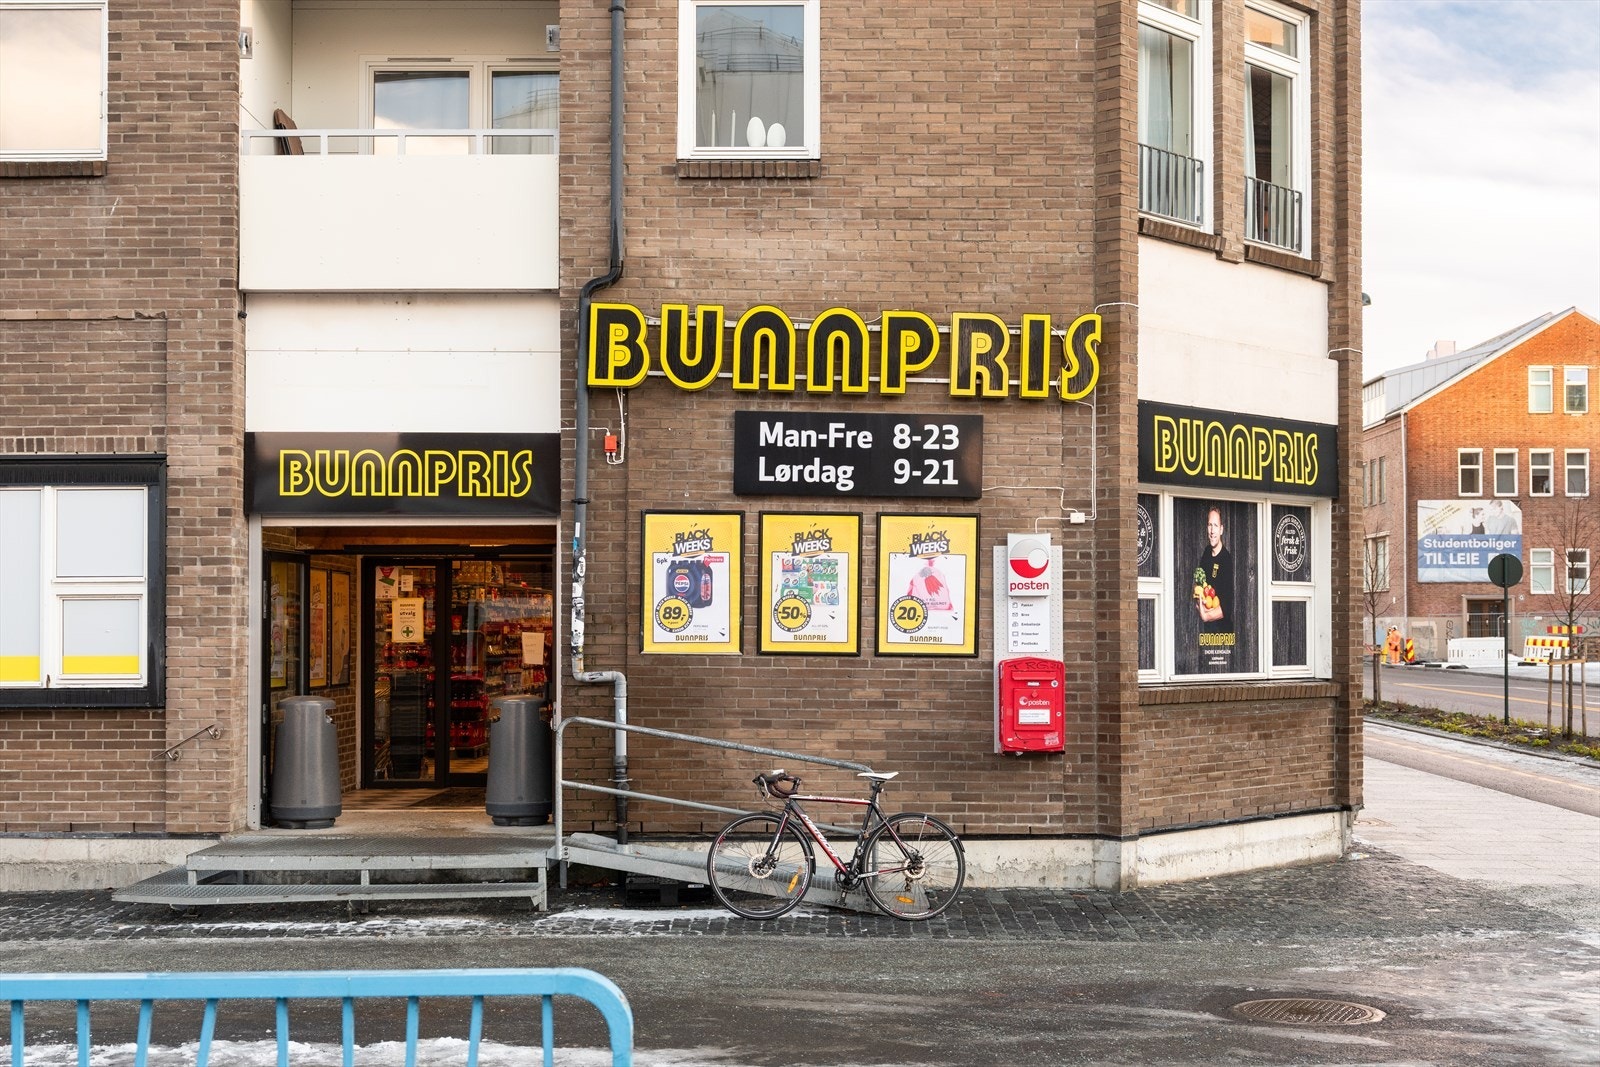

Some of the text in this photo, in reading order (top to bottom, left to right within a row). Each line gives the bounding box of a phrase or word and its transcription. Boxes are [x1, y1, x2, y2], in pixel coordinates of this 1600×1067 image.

[588, 302, 1101, 400] BUNNPRIS
[758, 421, 960, 451] Man-Fre 8-23
[1154, 415, 1318, 486] BUNNPRIS
[279, 449, 533, 498] BUNNPRIS
[758, 457, 959, 491] Lørdag 9-21
[675, 528, 711, 541] BLACK
[794, 528, 830, 541] BLACK
[912, 530, 948, 543] BLACK
[675, 539, 711, 554] WEEKS
[794, 539, 830, 554] WEEKS
[912, 540, 948, 556] WEEKS
[1423, 538, 1517, 550] Studentboliger
[1423, 552, 1445, 565] TIL
[1449, 552, 1480, 565] LEIE
[1010, 580, 1049, 592] posten
[1199, 633, 1236, 646] BUNNPRIS
